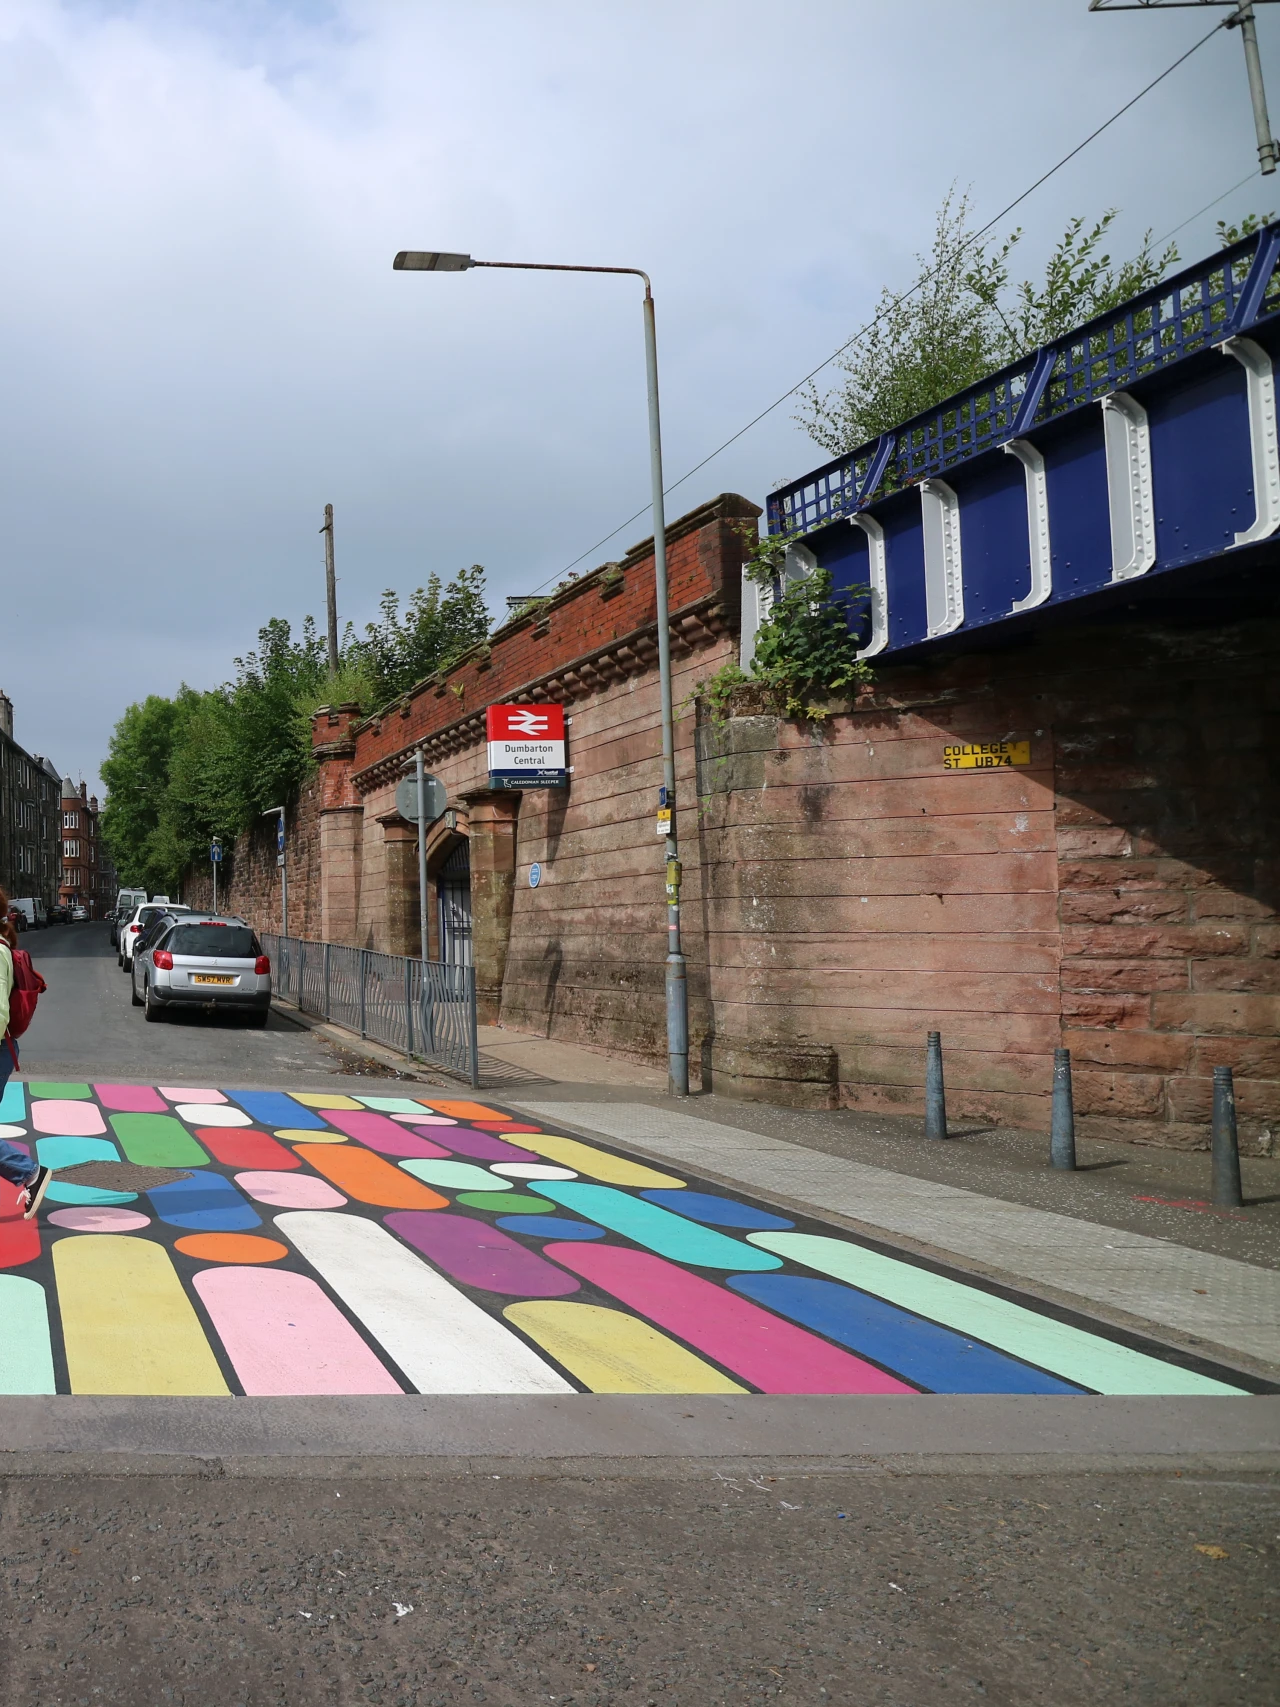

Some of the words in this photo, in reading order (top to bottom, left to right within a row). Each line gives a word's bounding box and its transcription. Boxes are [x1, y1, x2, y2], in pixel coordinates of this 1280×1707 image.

[505, 744, 553, 753] Dumbarton
[943, 743, 1008, 756] COLLEGE
[514, 756, 545, 765] Central
[943, 758, 961, 769] ST
